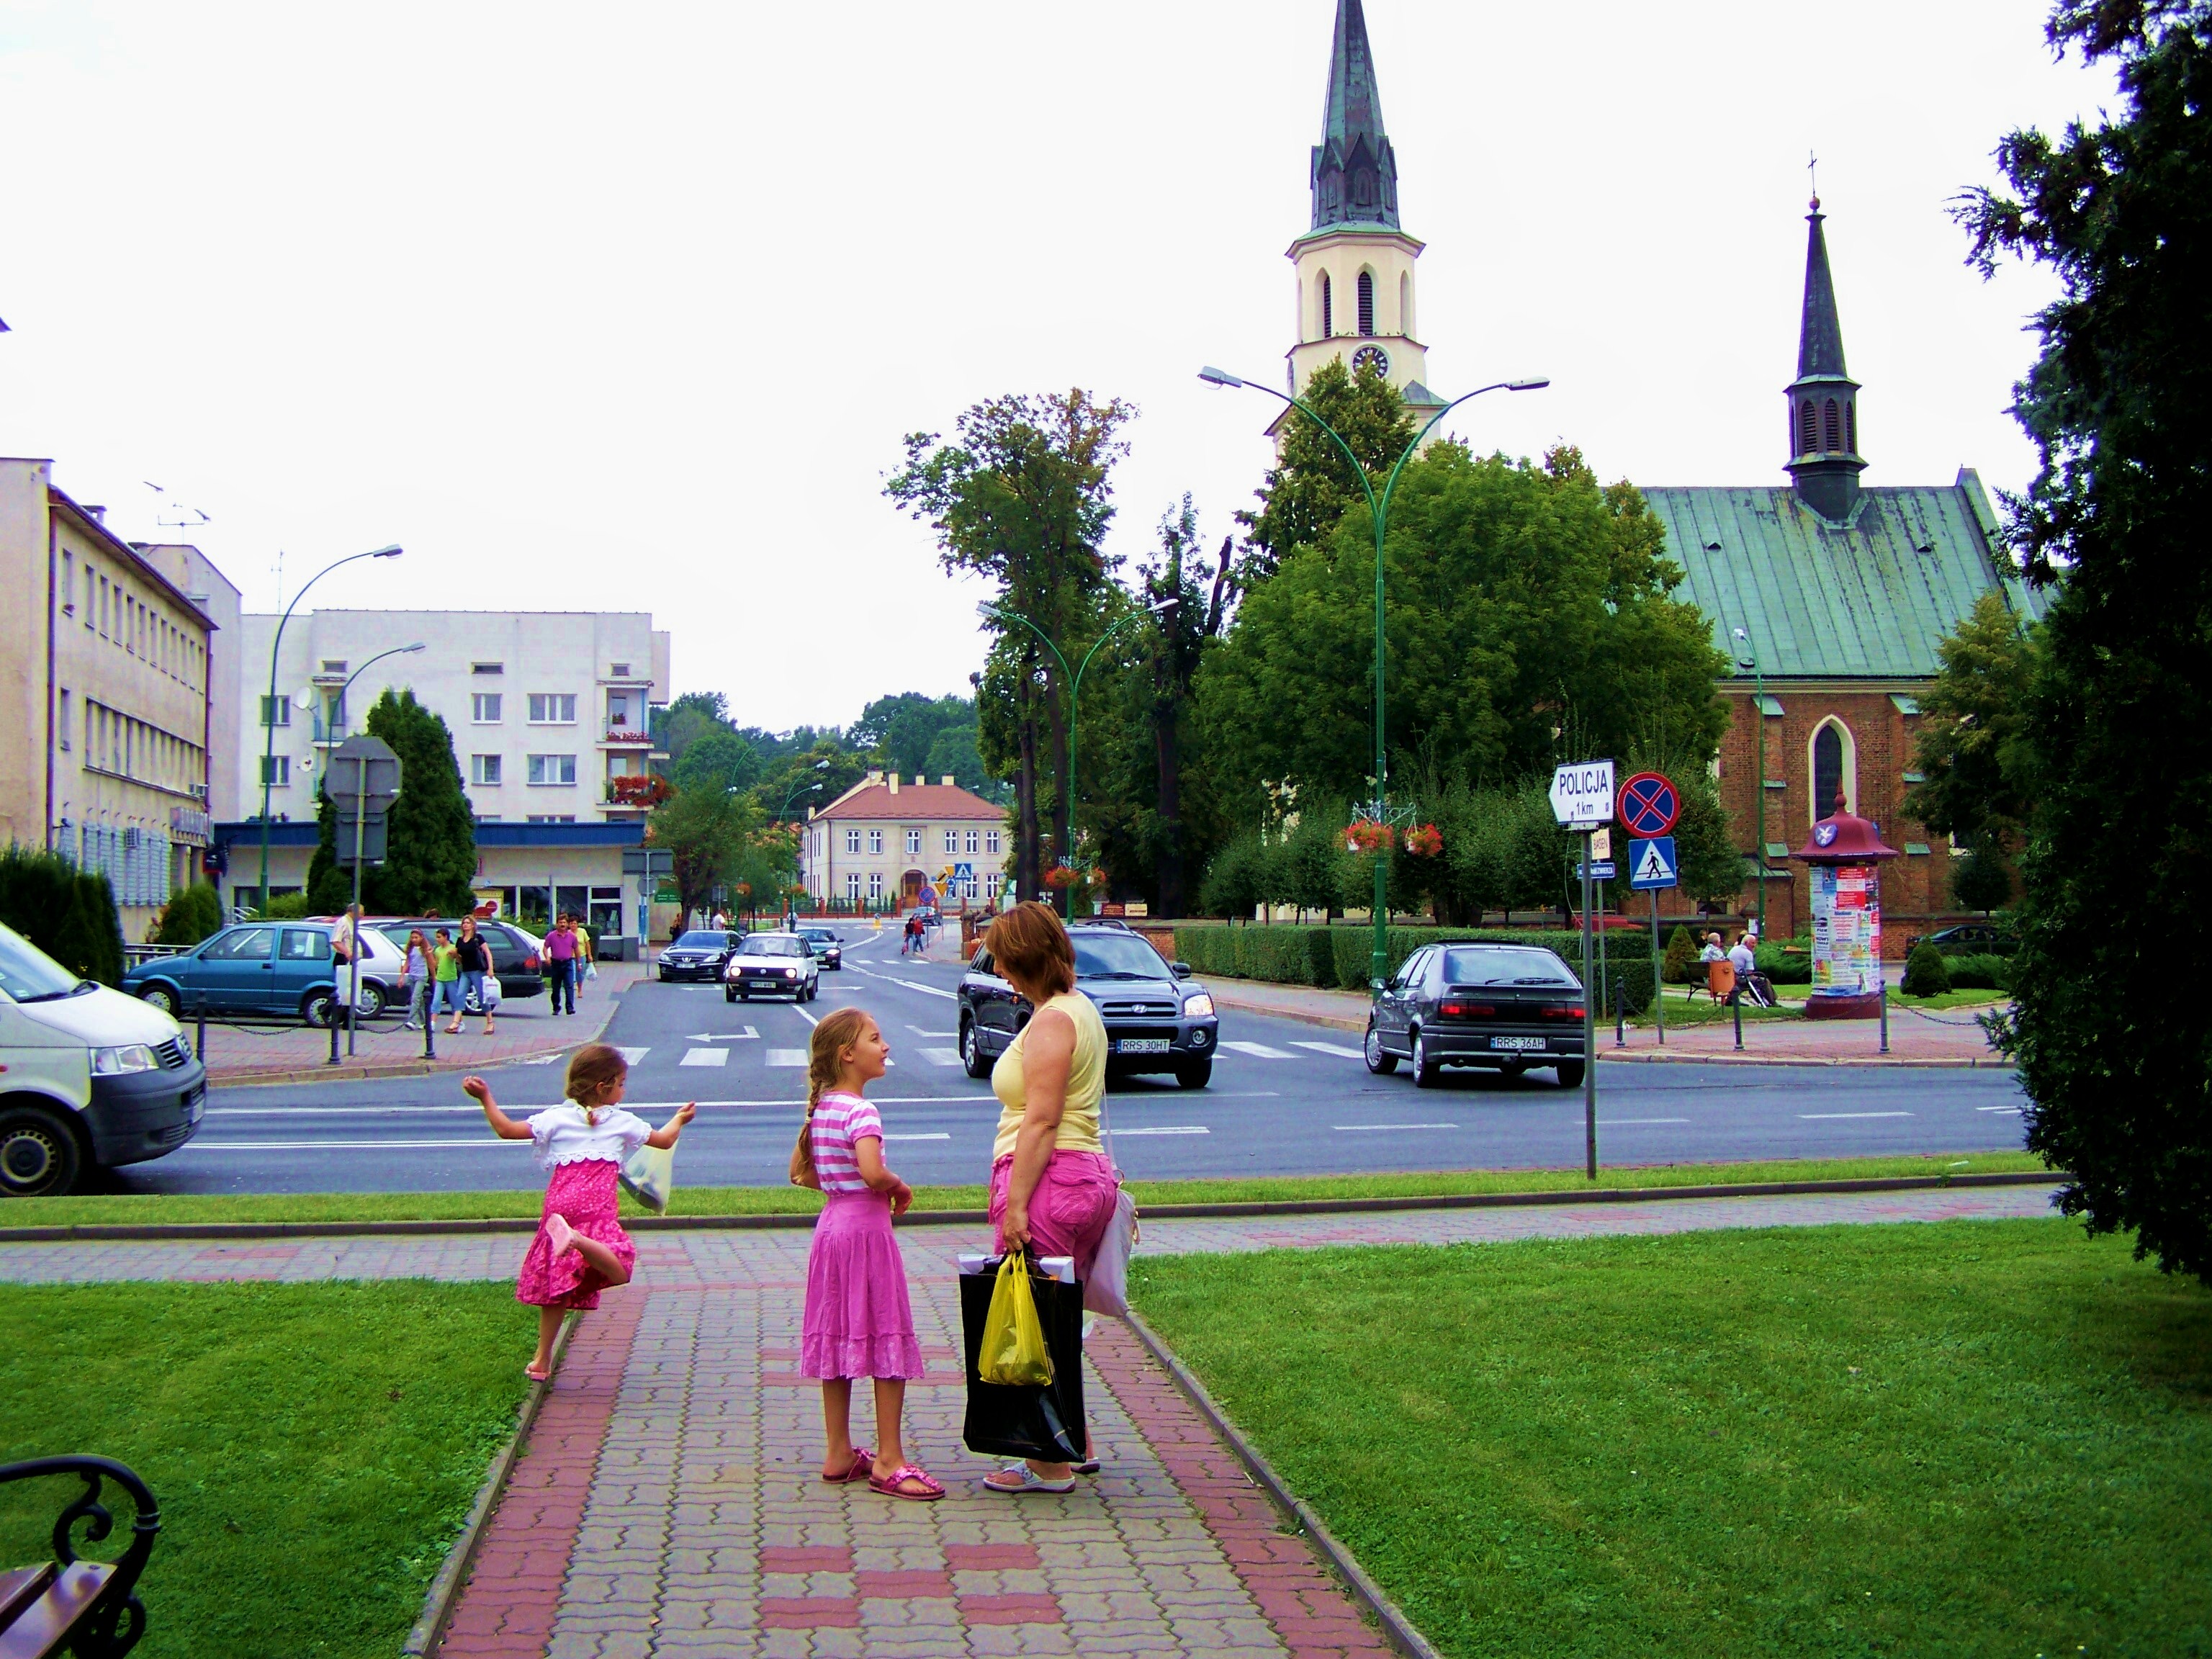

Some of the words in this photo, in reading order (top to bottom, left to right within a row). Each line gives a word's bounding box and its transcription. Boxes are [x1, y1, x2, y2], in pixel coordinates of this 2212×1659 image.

[1560, 770, 1608, 796] POLICJA
[1123, 1040, 1143, 1050] RRS
[1146, 1040, 1168, 1050] 30HT
[1497, 1038, 1517, 1048] RRS
[1521, 1038, 1544, 1048] 36AH
